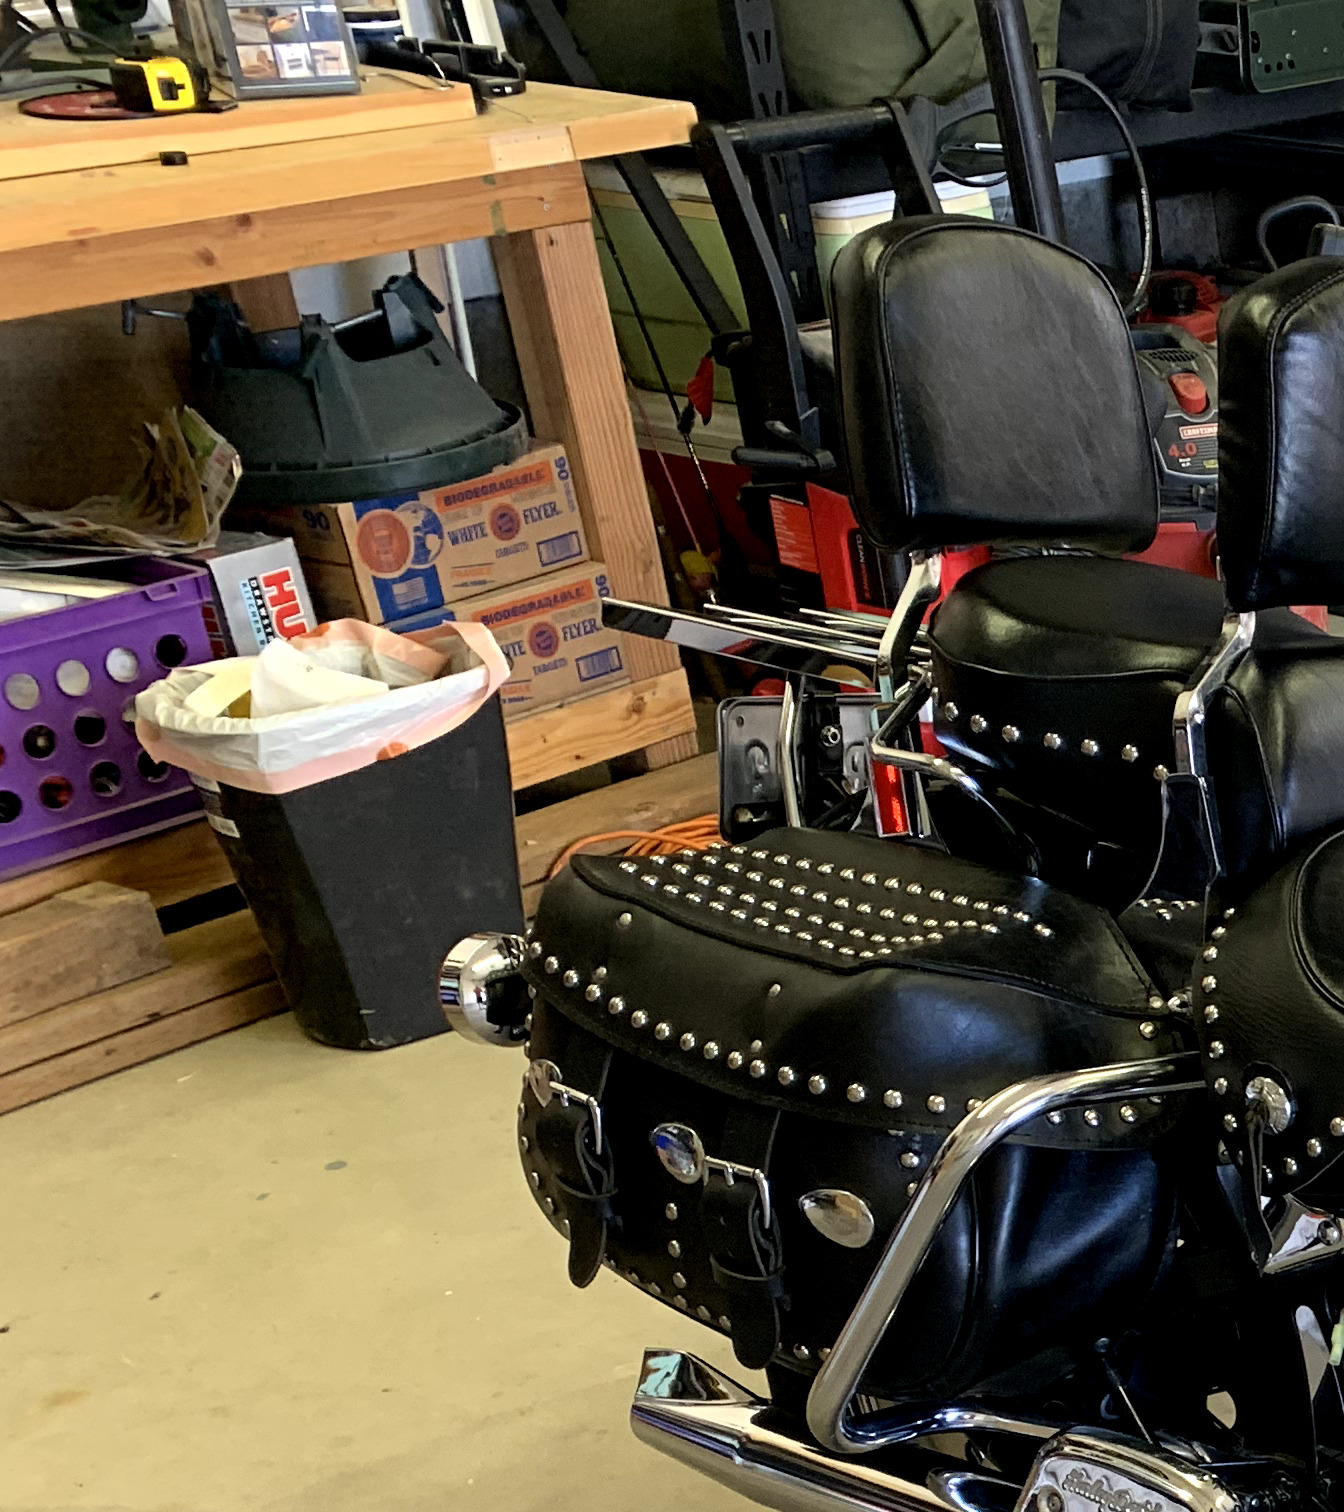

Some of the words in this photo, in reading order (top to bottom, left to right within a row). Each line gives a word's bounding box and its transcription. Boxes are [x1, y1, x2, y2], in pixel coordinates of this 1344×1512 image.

[555, 456, 570, 481] 90
[302, 509, 331, 532] 90
[448, 522, 488, 546] WHITE
[523, 501, 560, 525] FLYER
[562, 617, 603, 642] FLYER
